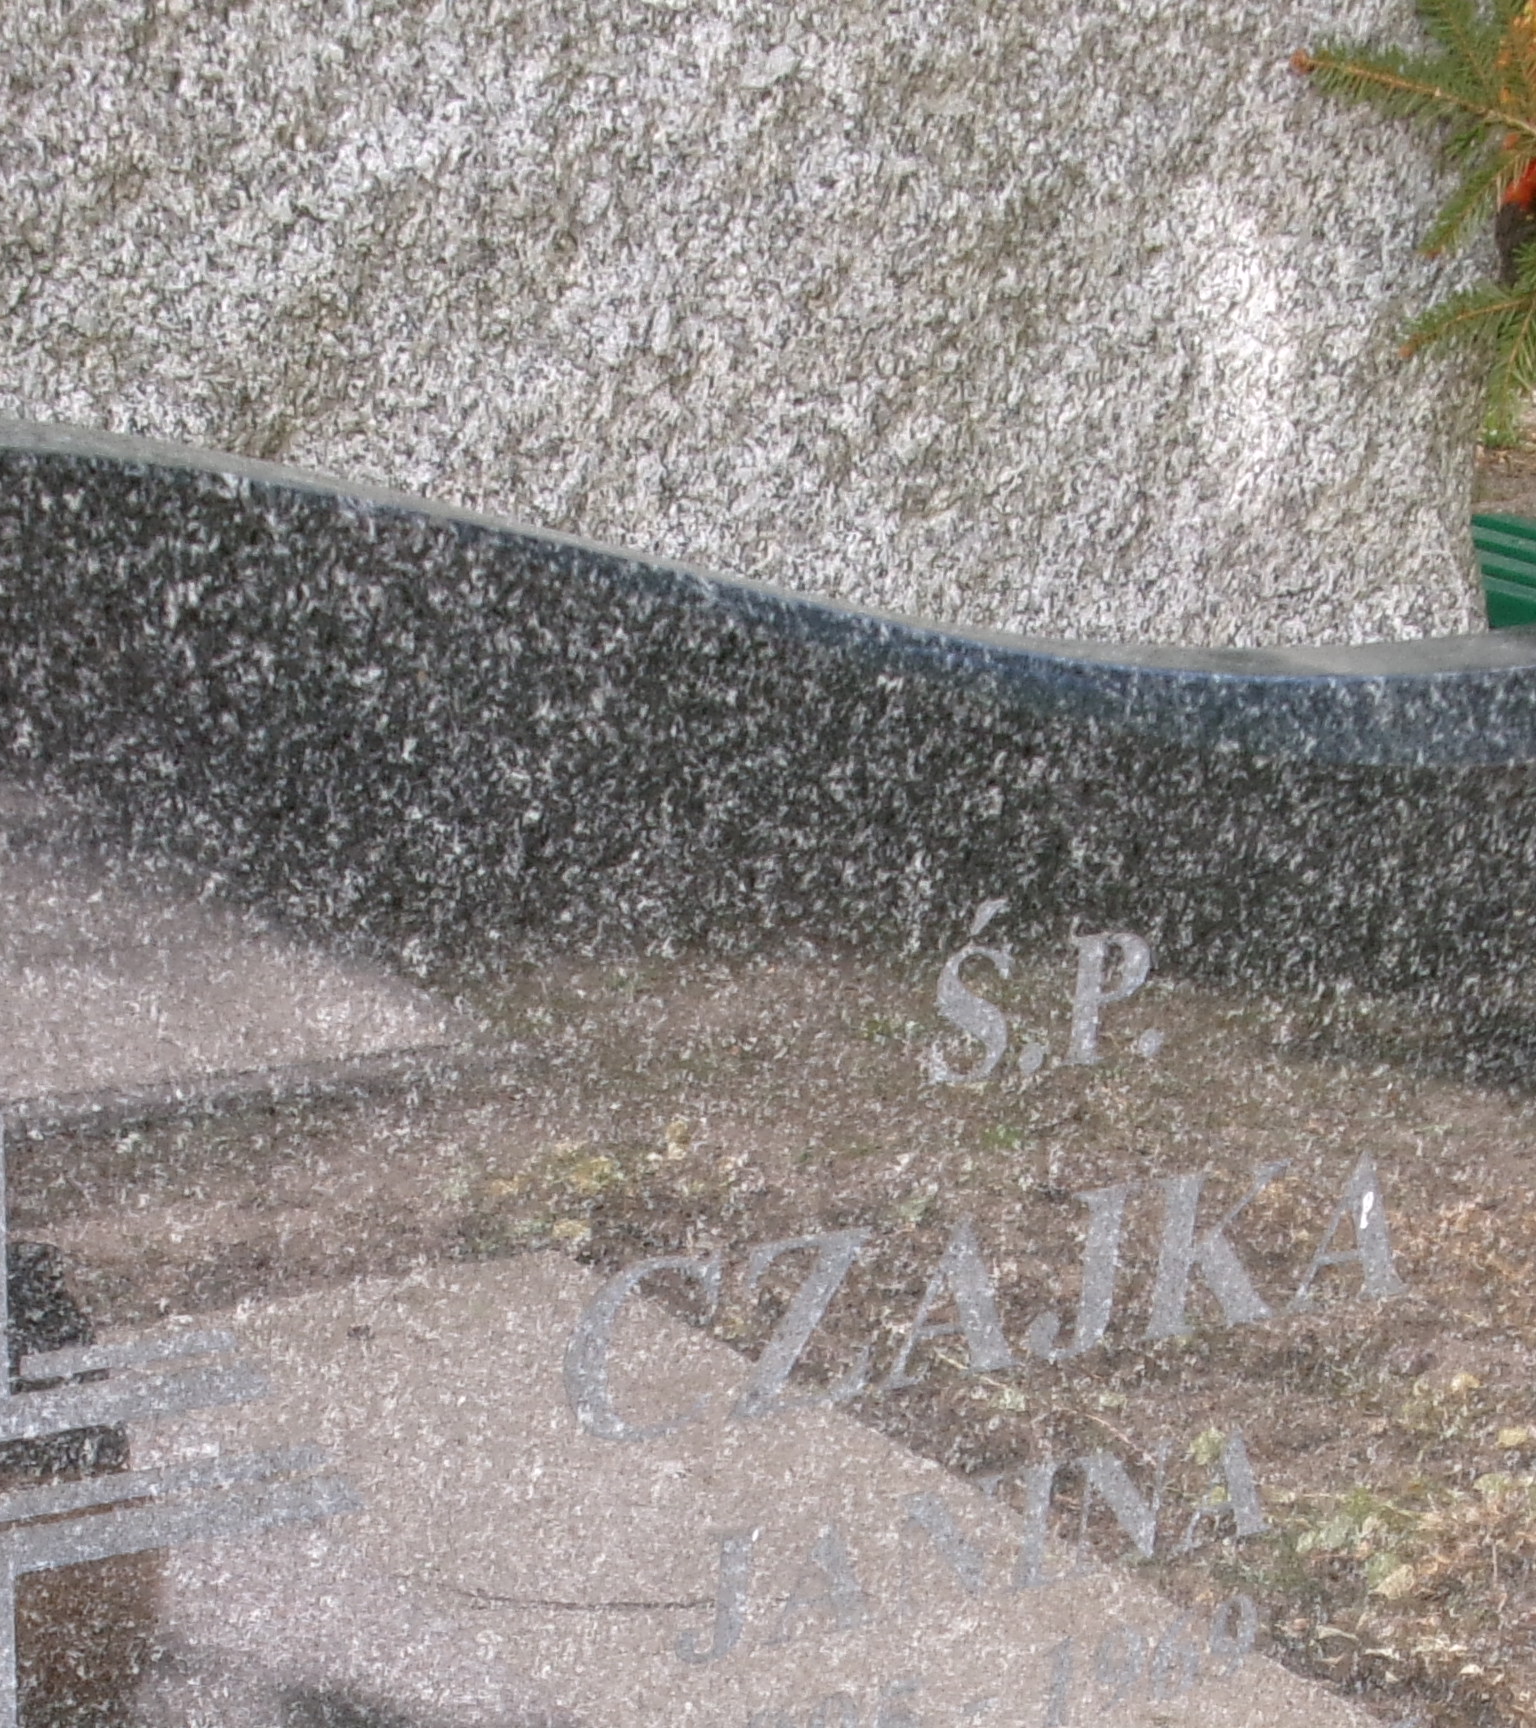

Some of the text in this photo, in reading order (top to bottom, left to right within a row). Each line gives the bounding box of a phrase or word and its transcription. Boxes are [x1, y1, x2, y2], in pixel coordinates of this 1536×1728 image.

[566, 1151, 1408, 1441] CZAJKA
[674, 1425, 1269, 1664] JANINA
[1039, 1591, 1260, 1728] 1969
